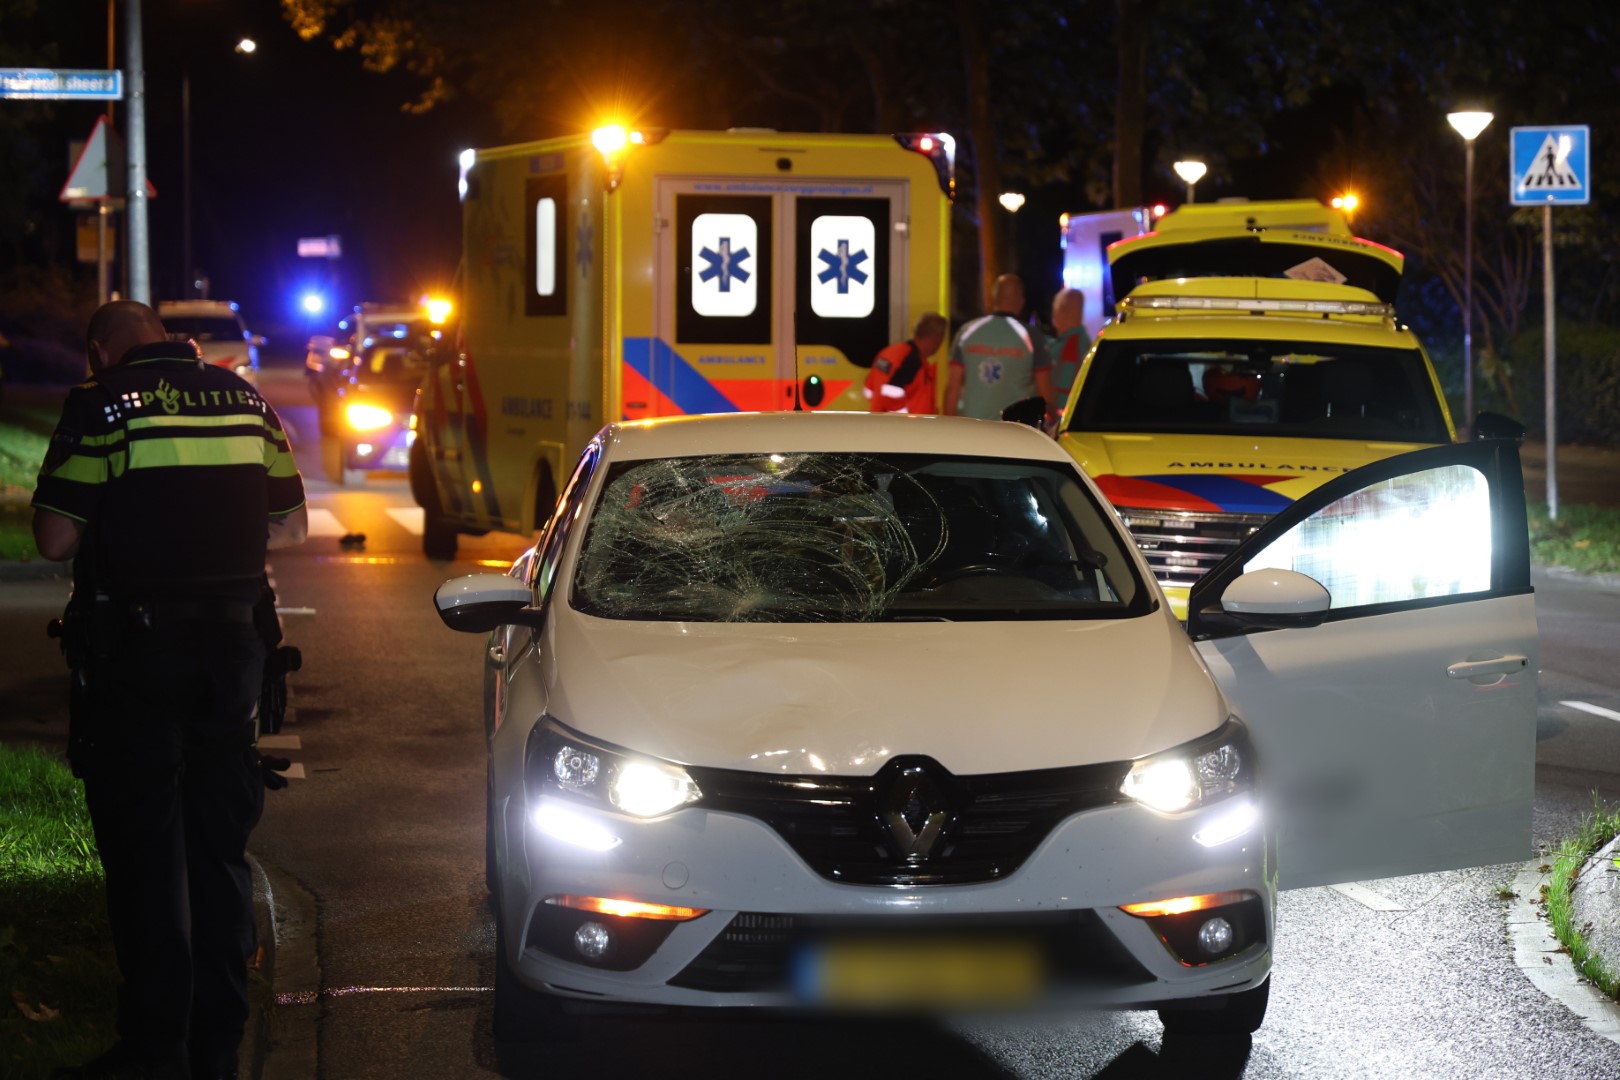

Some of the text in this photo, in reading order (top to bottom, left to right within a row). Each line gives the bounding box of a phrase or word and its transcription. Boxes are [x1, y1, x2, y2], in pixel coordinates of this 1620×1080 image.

[698, 354, 766, 364] AMBULANCE
[142, 388, 246, 414] POLITIE
[502, 396, 553, 420] AMBULANCE
